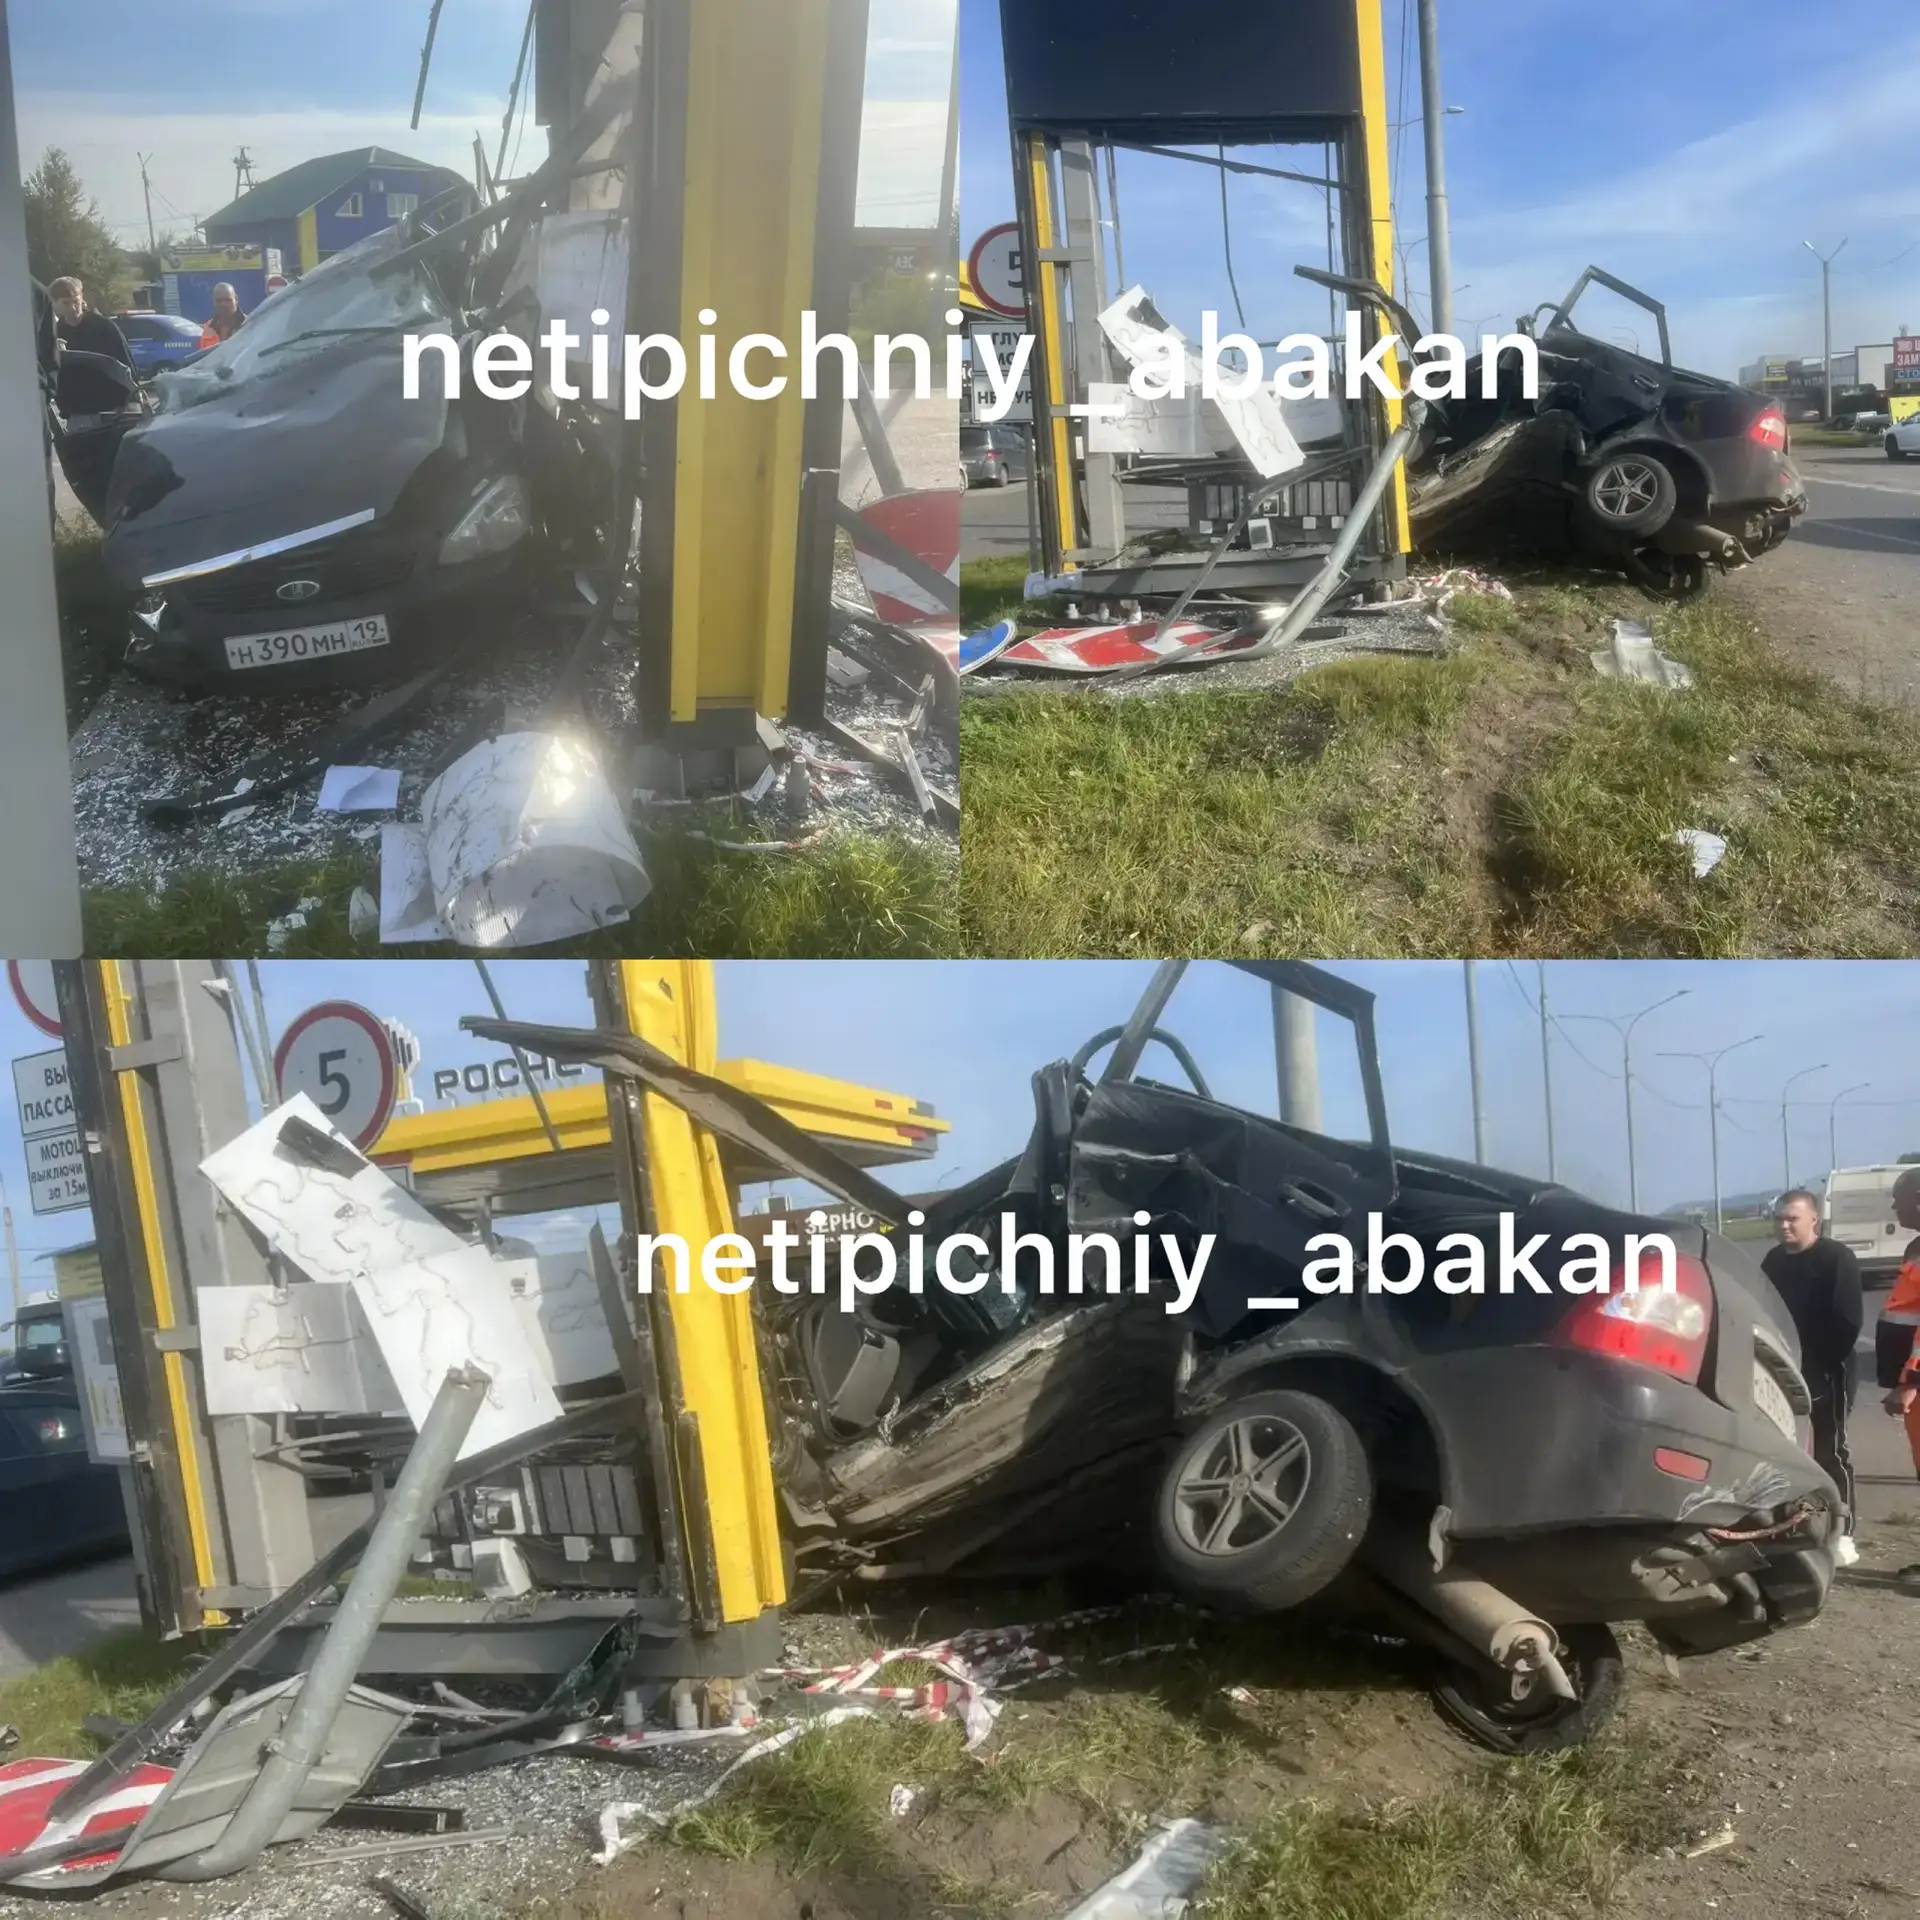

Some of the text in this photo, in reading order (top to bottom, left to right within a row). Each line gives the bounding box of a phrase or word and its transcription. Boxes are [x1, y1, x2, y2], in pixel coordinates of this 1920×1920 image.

[992, 332, 1023, 345] ГЛУ
[1897, 353, 1920, 366] ЗАМ
[354, 620, 378, 639] 19
[44, 1064, 67, 1087] ВЫ
[318, 1048, 350, 1115] 5
[23, 1094, 75, 1122] ПАССА
[66, 1180, 88, 1197] 15м
